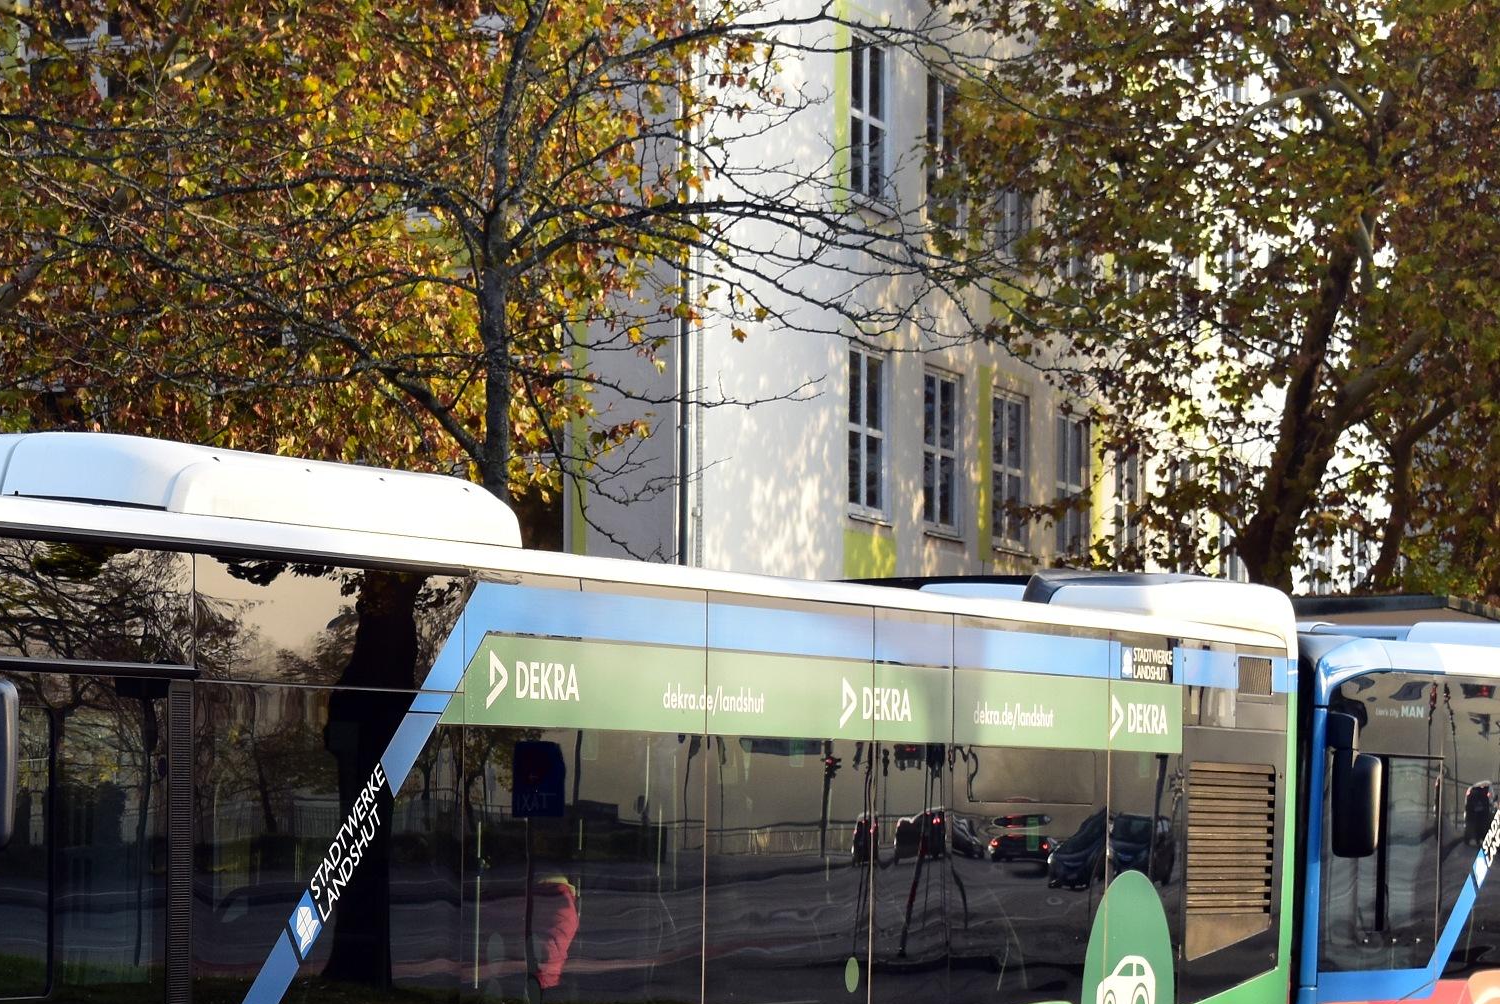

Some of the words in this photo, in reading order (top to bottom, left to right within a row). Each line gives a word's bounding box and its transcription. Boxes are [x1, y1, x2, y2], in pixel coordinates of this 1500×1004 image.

[1133, 647, 1173, 665] STADTWERKE
[1133, 664, 1167, 680] LANDSHUT
[515, 661, 580, 701] DEKRA
[662, 682, 765, 716] dekra.de/landshut
[862, 687, 912, 722] DEKRA
[1401, 704, 1424, 718] MAN
[973, 702, 1054, 731] dekra.de/landshut
[1127, 703, 1168, 735] DEKRA
[310, 763, 385, 899] STADTWERKE
[318, 803, 381, 922] LANDSHUT
